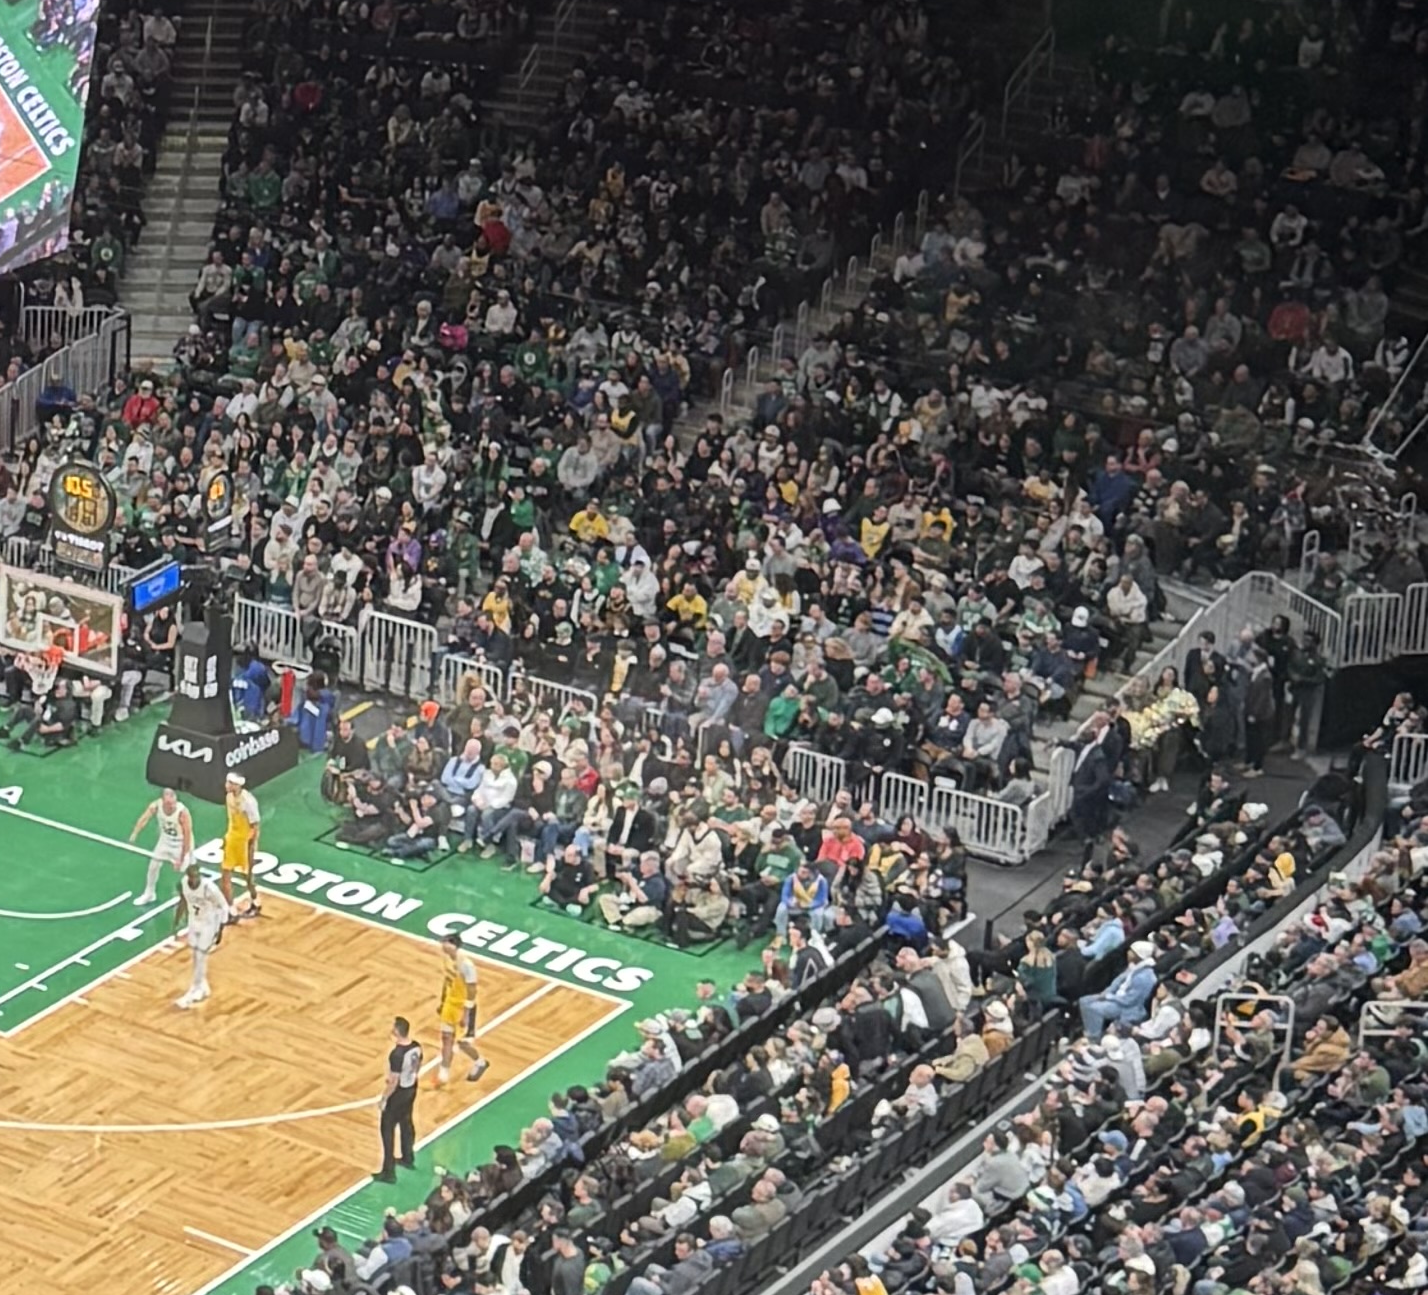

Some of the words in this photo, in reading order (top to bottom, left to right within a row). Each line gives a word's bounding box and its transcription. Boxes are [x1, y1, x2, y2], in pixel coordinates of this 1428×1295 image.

[12, 84, 79, 158] CELTICS
[224, 728, 282, 769] coinbase
[195, 837, 424, 922] BOSTON
[425, 911, 655, 993] CELTICS
